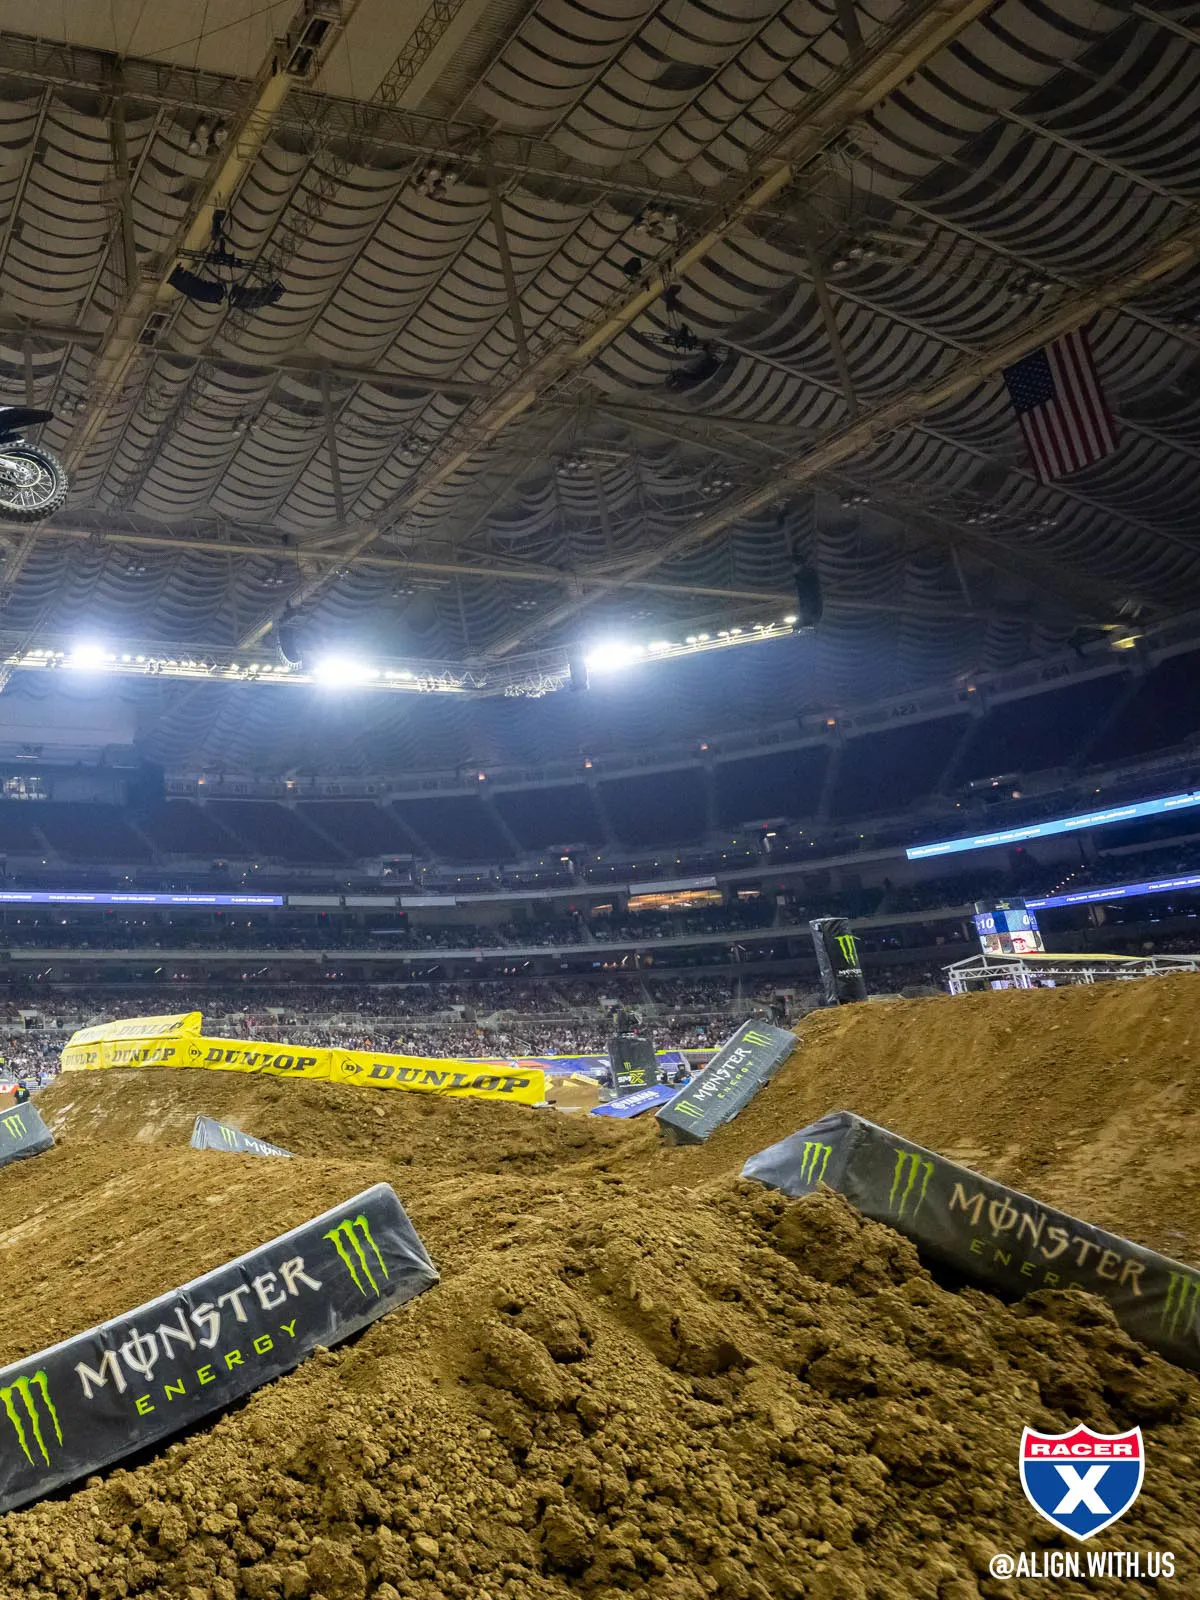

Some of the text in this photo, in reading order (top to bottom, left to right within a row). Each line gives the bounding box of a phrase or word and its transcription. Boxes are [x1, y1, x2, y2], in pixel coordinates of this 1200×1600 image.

[204, 1047, 318, 1072] DUNLOP
[366, 1063, 532, 1093] DUNLOP
[693, 1047, 753, 1102] MONSTER
[717, 1060, 754, 1100] ENERGY
[948, 1182, 1147, 1297] MONSTER
[74, 1255, 323, 1400] MONSTER
[134, 1317, 298, 1416] ENERGY
